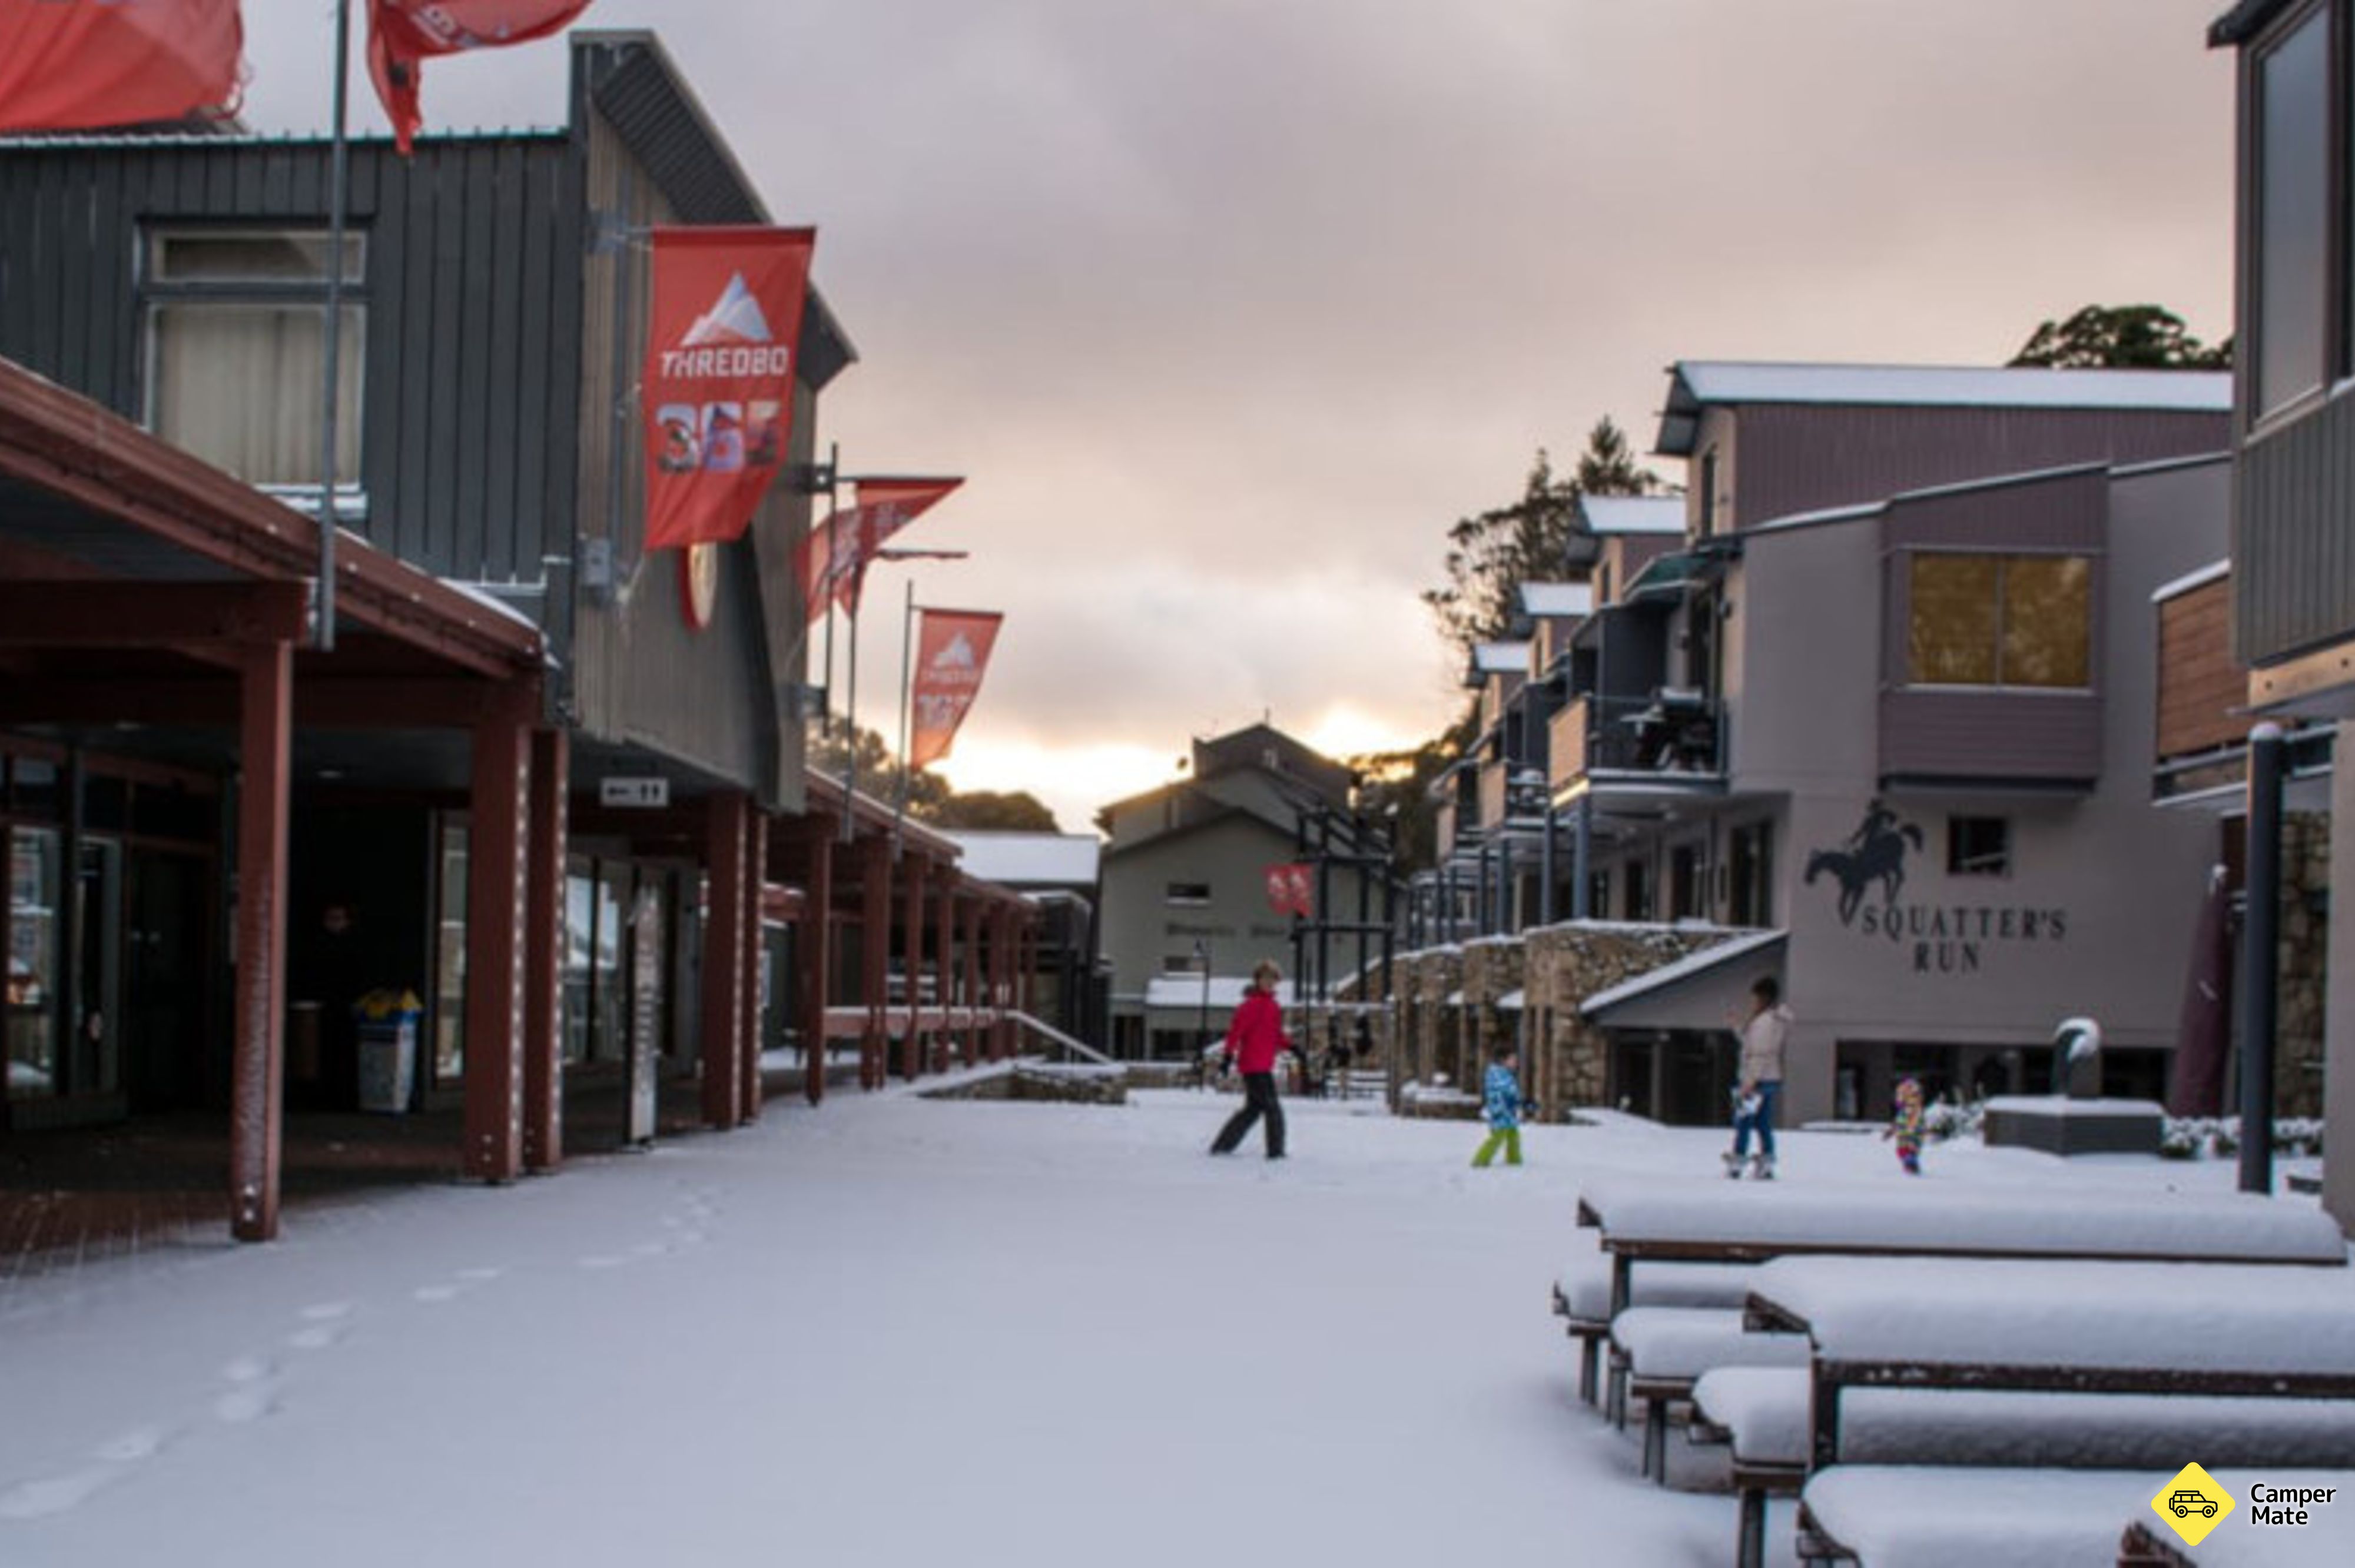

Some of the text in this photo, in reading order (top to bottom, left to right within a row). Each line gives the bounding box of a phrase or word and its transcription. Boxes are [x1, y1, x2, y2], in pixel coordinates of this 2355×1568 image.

[661, 347, 789, 378] THREDBO
[656, 401, 781, 473] 365
[1862, 905, 2067, 941] SQUATTER'S
[1913, 943, 1979, 972] RUN
